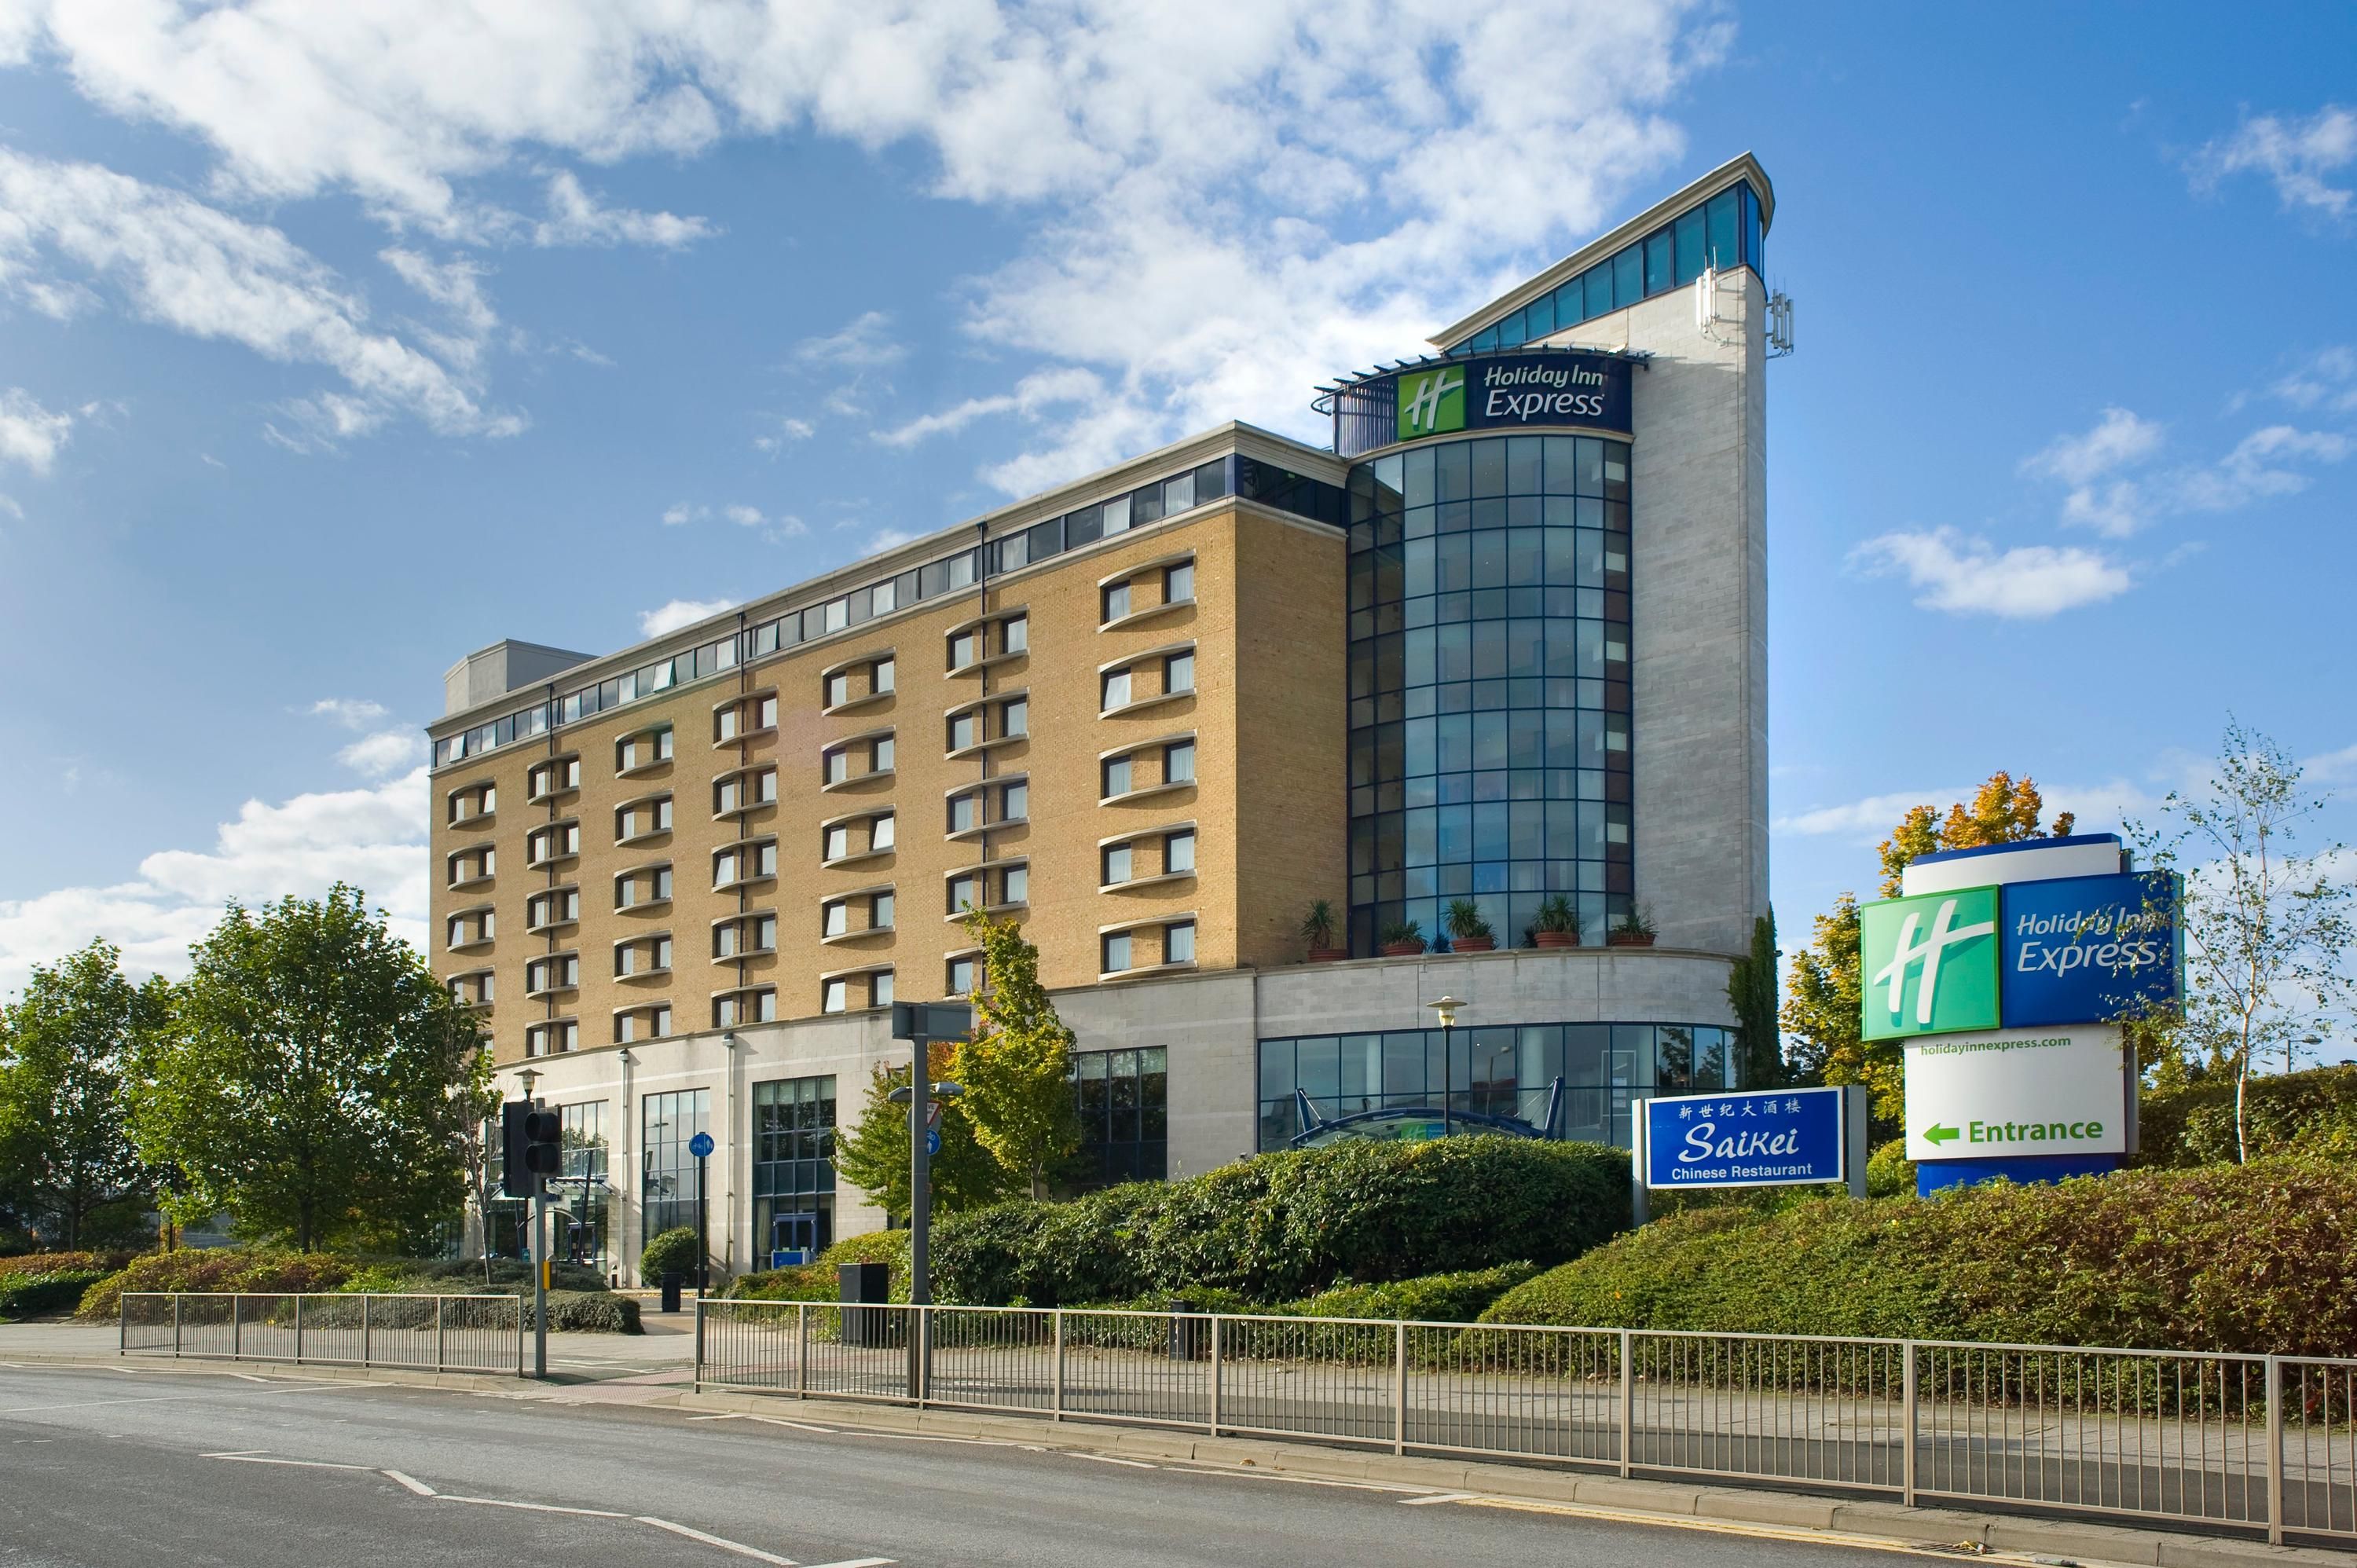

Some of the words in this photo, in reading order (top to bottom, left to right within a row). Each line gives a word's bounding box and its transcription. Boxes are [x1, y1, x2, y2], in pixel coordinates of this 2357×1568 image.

[1483, 364, 1569, 388] Holiday
[1571, 364, 1604, 386] Inn
[1485, 389, 1604, 422] Express
[2116, 907, 2155, 933] In
[2017, 941, 2158, 977] Express
[1920, 1037, 2071, 1056] holidayinnexpress.com
[1678, 1097, 1802, 1121] 新世纪大酒楼
[1969, 1120, 2104, 1144] Entrance
[1671, 1167, 1727, 1180] Chinese
[1731, 1163, 1813, 1178] Restaurant
